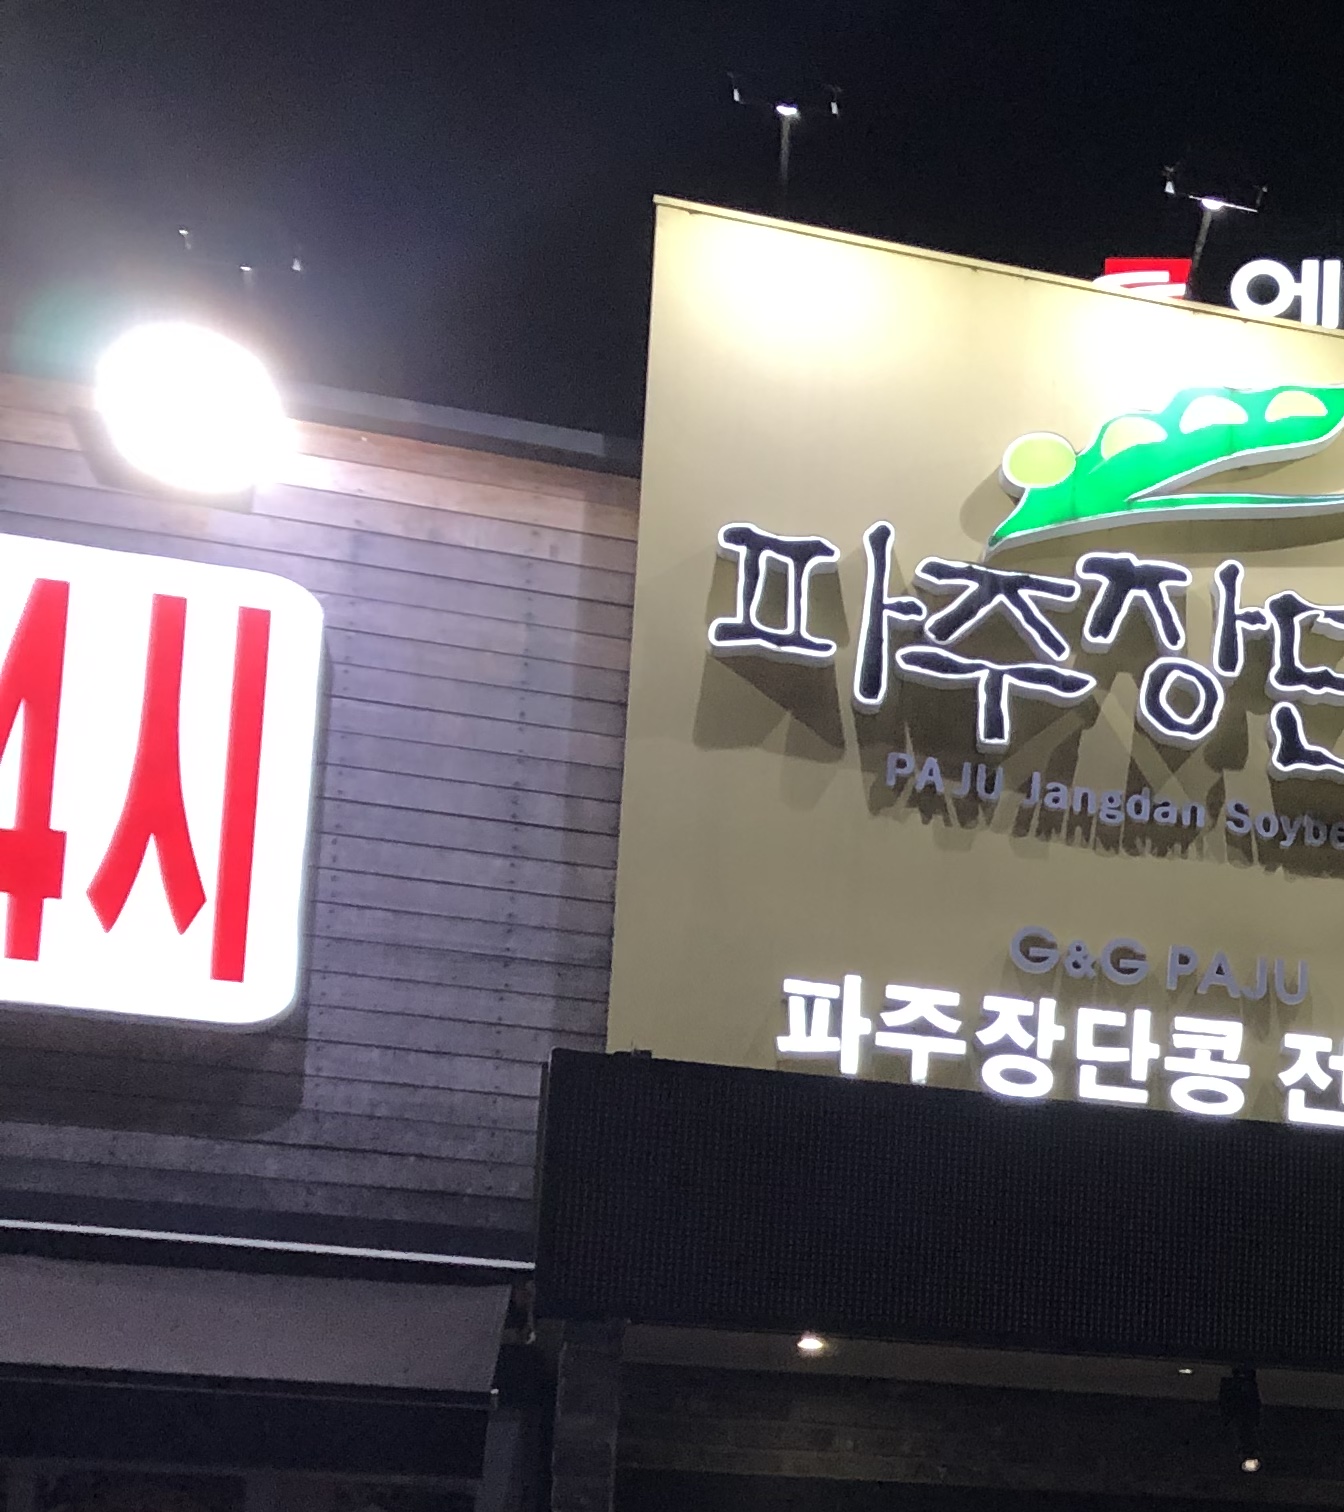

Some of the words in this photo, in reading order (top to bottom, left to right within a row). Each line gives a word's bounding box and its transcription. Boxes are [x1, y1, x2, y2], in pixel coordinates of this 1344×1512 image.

[884, 750, 1003, 802] PAJU
[1029, 768, 1207, 829] Jangdan
[1010, 924, 1151, 986] G&G
[1165, 943, 1311, 1006] PAJU
[774, 973, 1252, 1118] 파주장단콩
